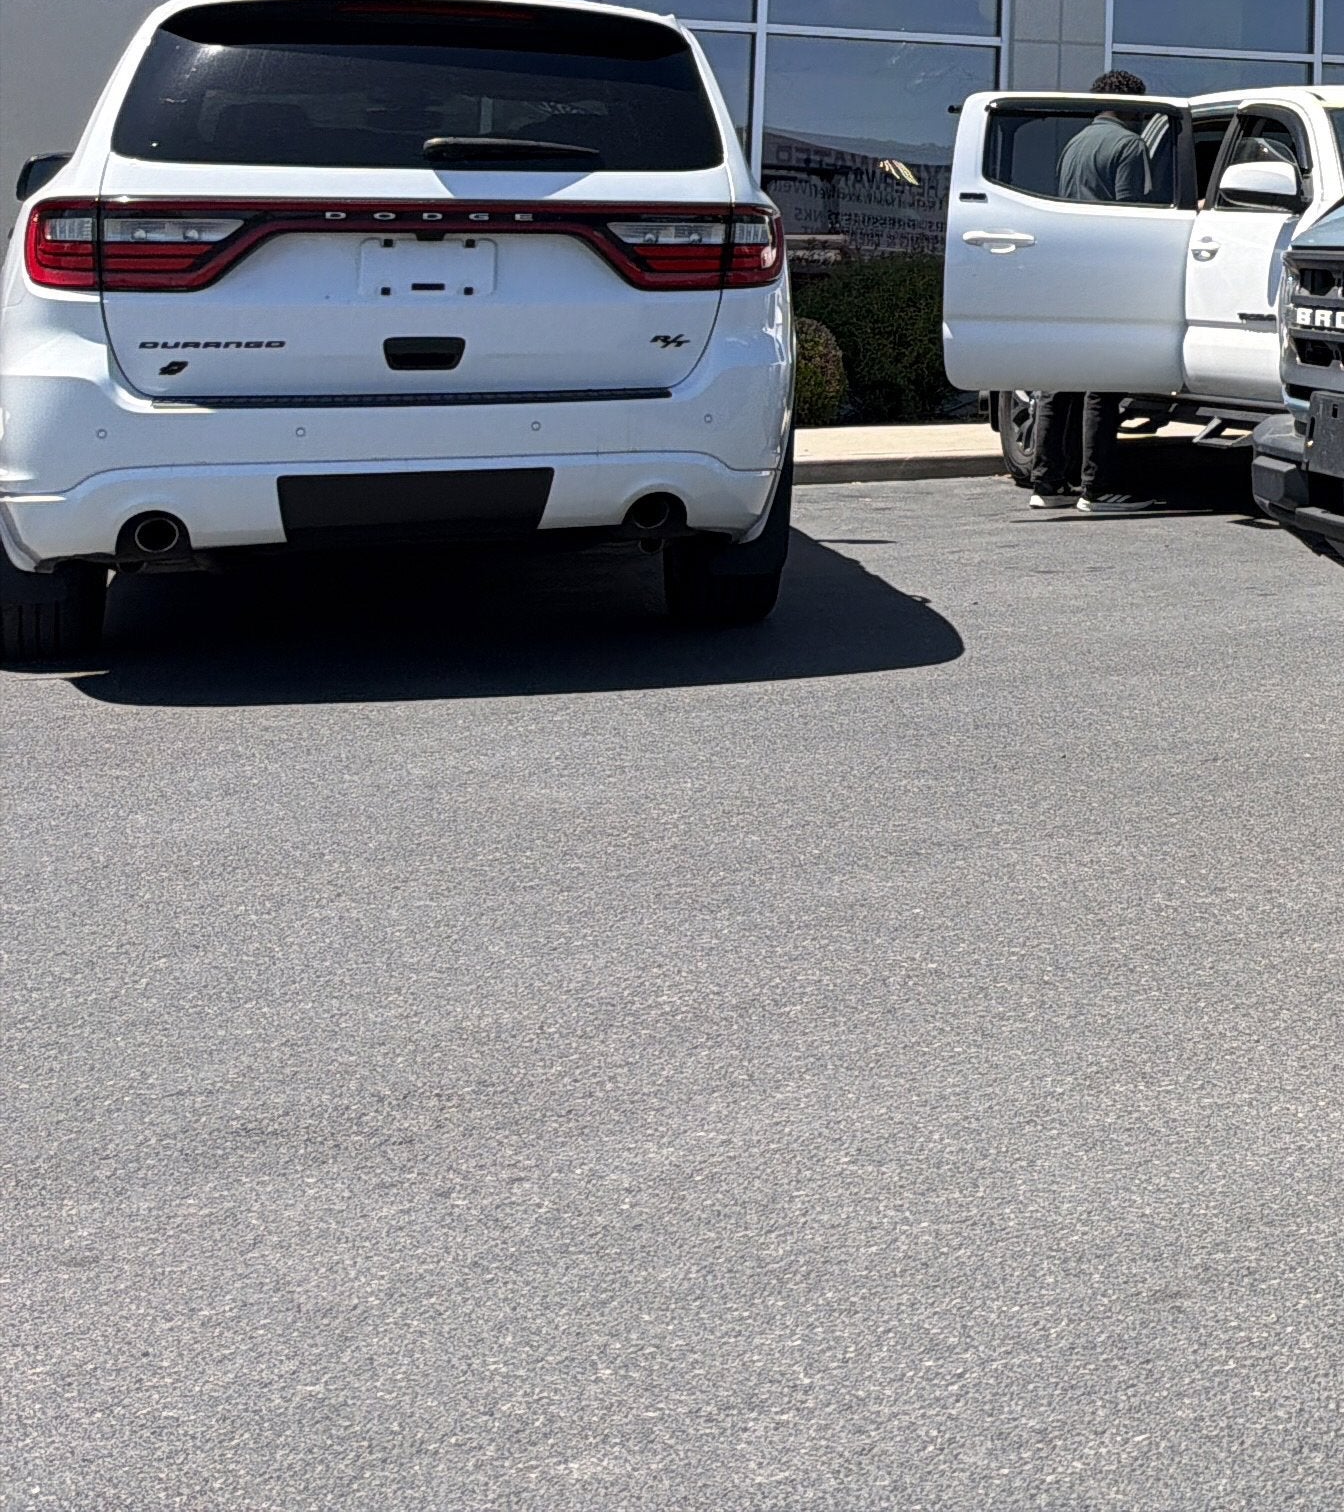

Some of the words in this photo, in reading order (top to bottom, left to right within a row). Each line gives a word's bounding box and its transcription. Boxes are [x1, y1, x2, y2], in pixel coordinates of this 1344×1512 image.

[324, 211, 534, 222] DODGE
[138, 340, 286, 349] DURANGO
[650, 333, 691, 349] R/T
